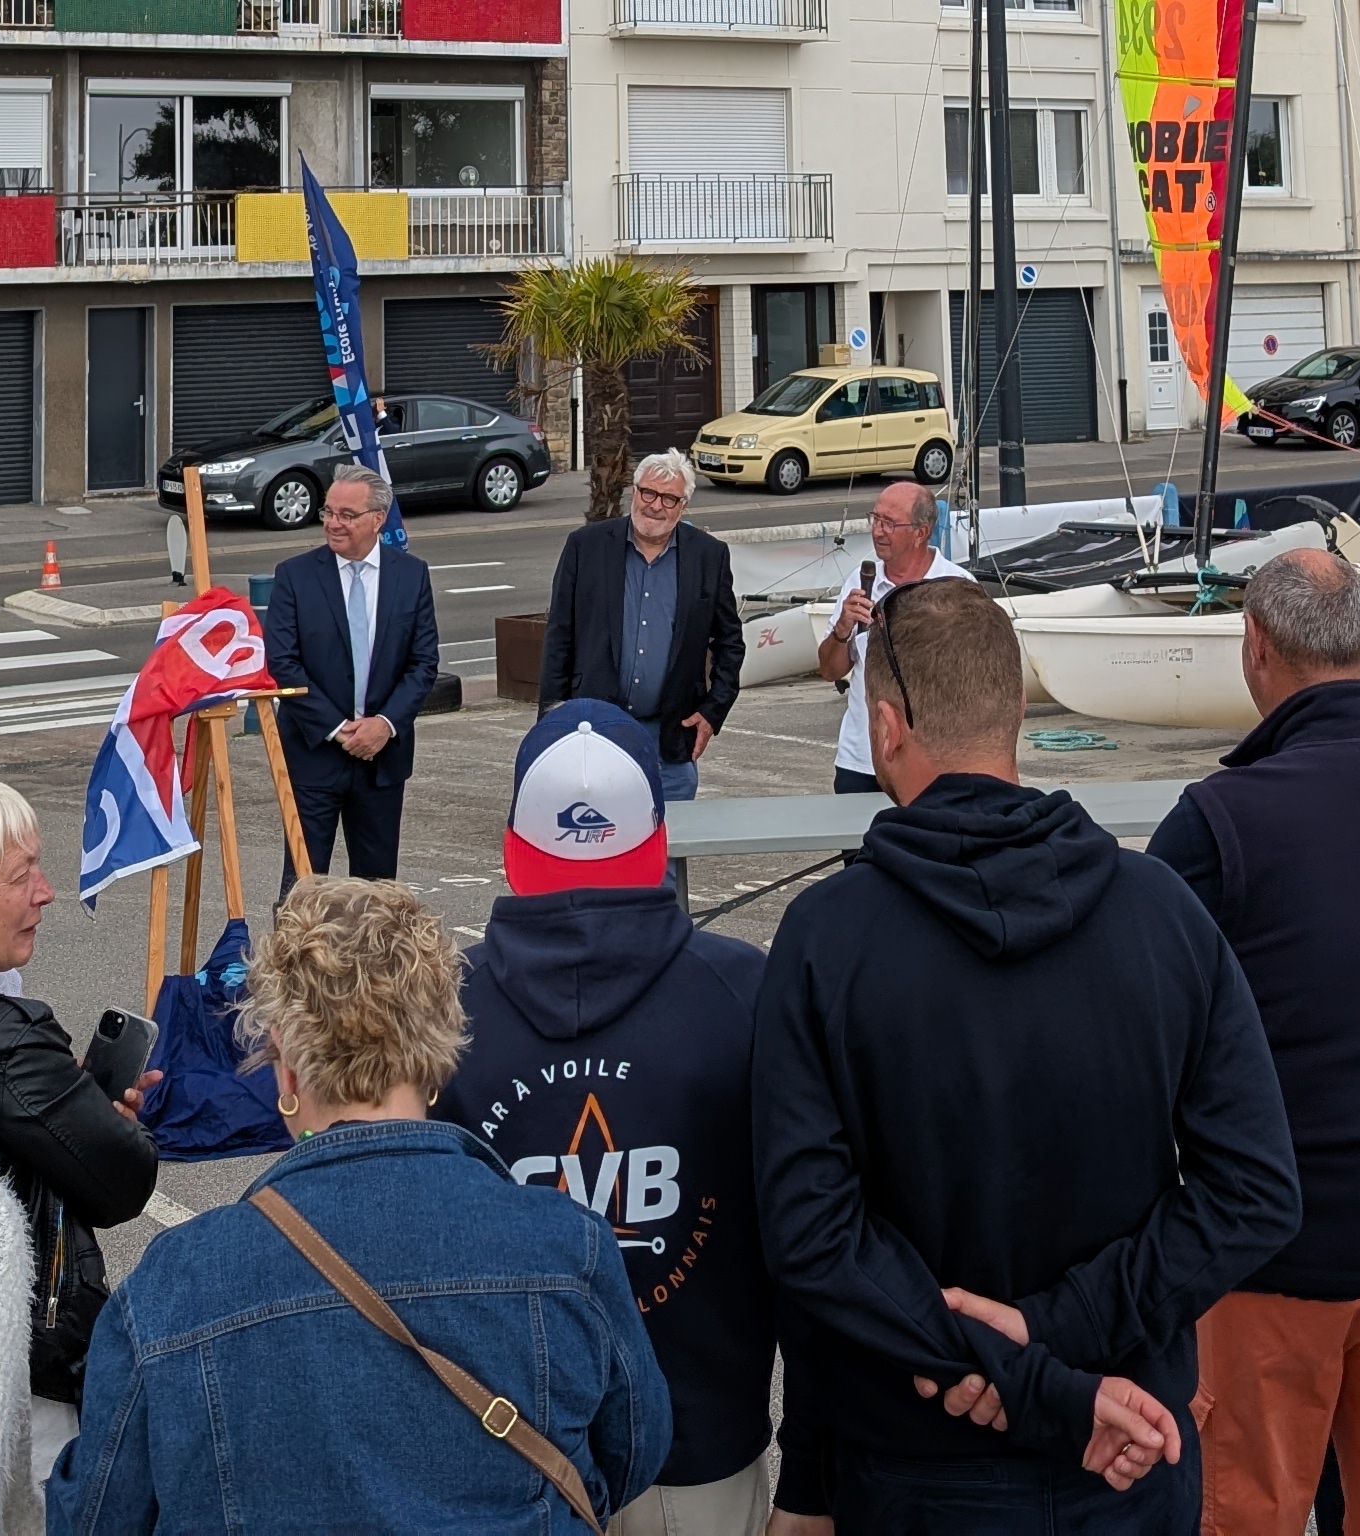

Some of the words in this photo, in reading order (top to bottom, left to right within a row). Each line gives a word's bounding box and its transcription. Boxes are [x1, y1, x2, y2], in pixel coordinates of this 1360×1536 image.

[1138, 169, 1204, 213] CAT
[511, 1078, 531, 1102] À
[540, 1058, 631, 1084] VOILE
